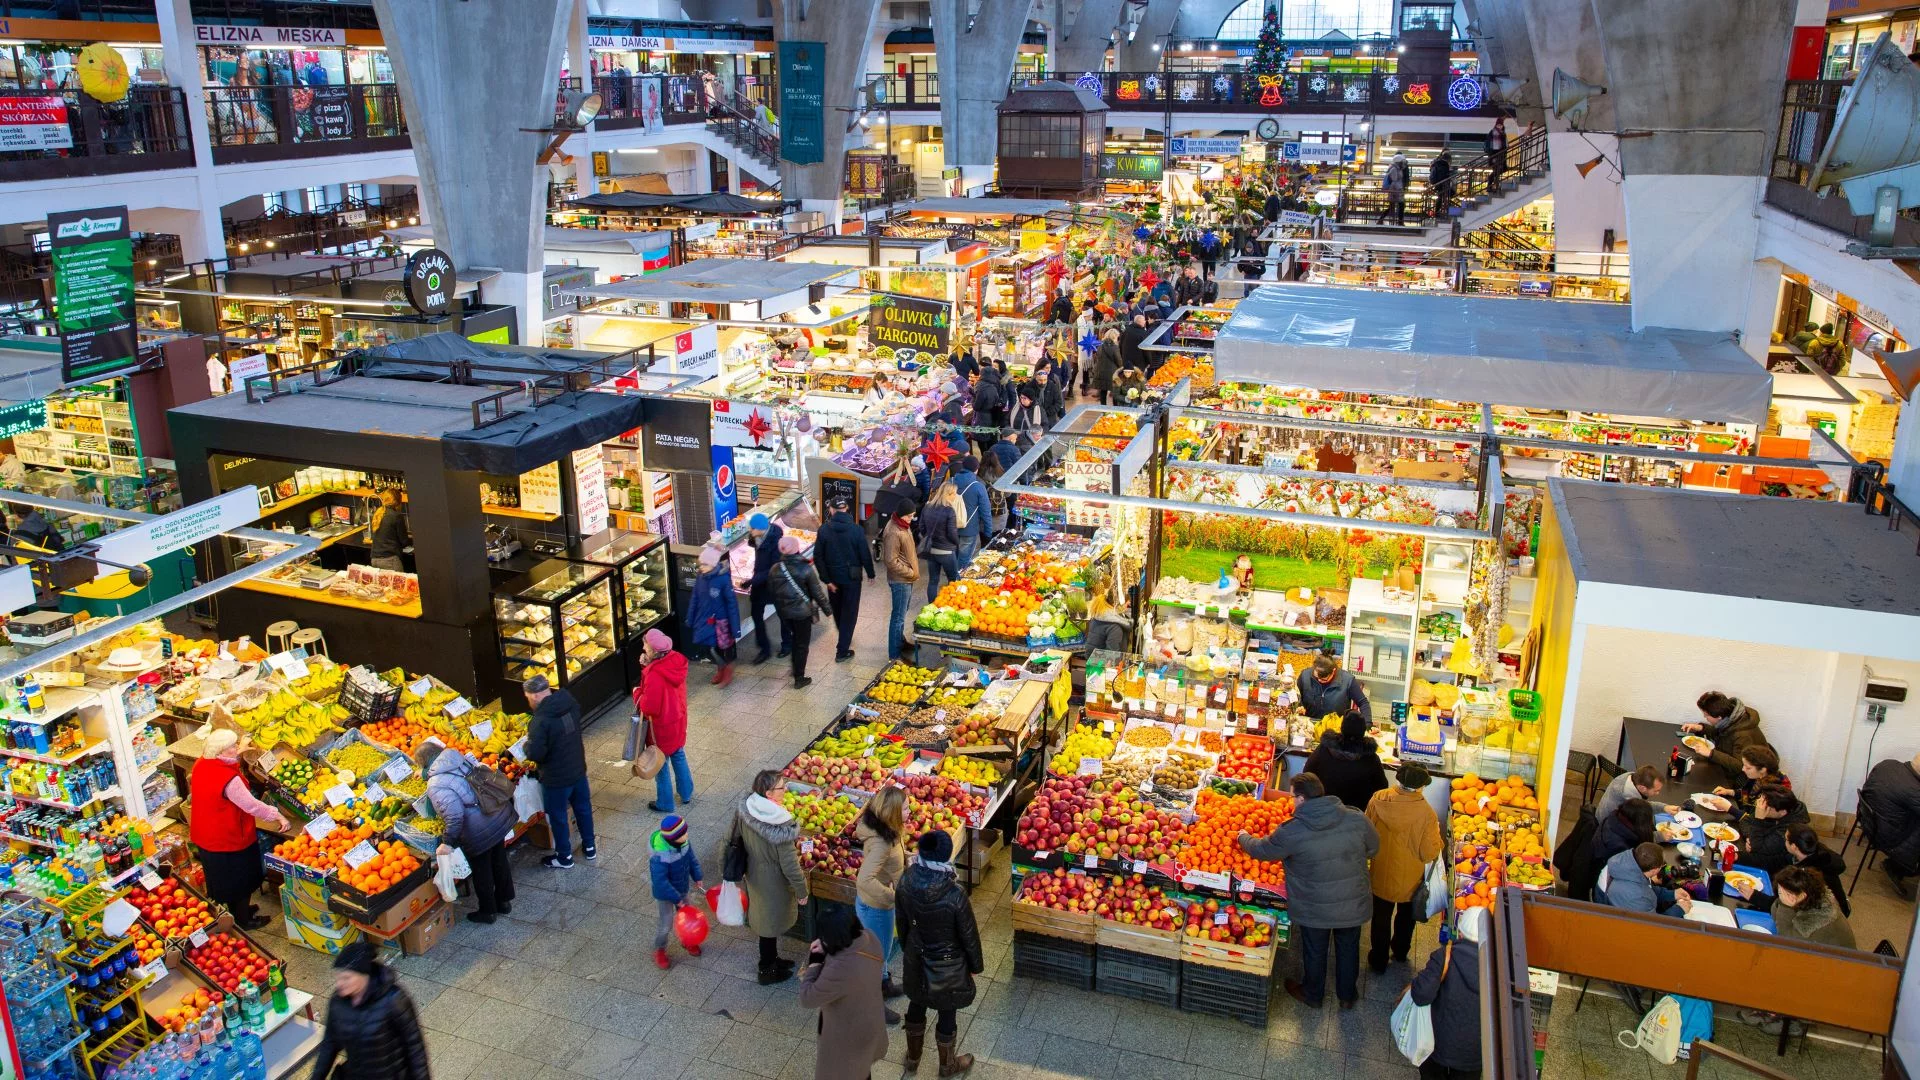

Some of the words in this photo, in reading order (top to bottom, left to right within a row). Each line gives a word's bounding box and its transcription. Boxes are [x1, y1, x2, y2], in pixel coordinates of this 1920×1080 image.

[277, 28, 335, 43] MĘSKA
[621, 37, 659, 48] DAMSKA
[323, 104, 341, 113] pizza
[2, 111, 57, 121] SKÓRZANA
[43, 131, 59, 139] paski
[326, 127, 342, 135] lody
[2, 133, 26, 141] portfele
[3, 138, 37, 147] rękawiczki
[44, 137, 69, 145] parasole
[1117, 156, 1159, 172] KWIATY
[416, 255, 450, 279] ORGANIC
[426, 292, 446, 308] POINT
[885, 307, 933, 327] OLIWKI
[876, 326, 939, 349] TARGOWA
[680, 355, 698, 369] TURECKI
[698, 349, 717, 361] MARKET
[715, 415, 742, 425] TURECKI
[655, 433, 673, 442] PATA
[673, 435, 700, 444] NEGRA
[579, 467, 602, 482] TURECKA
[583, 479, 598, 491] KAWA
[581, 494, 604, 509] TURECKA
[151, 526, 179, 540] KRAJOWE
[183, 511, 222, 529] ZAGRANICZNE
[173, 529, 192, 539] stoisko
[187, 523, 220, 540] BARTOSZKO
[1122, 862, 1129, 870] K
